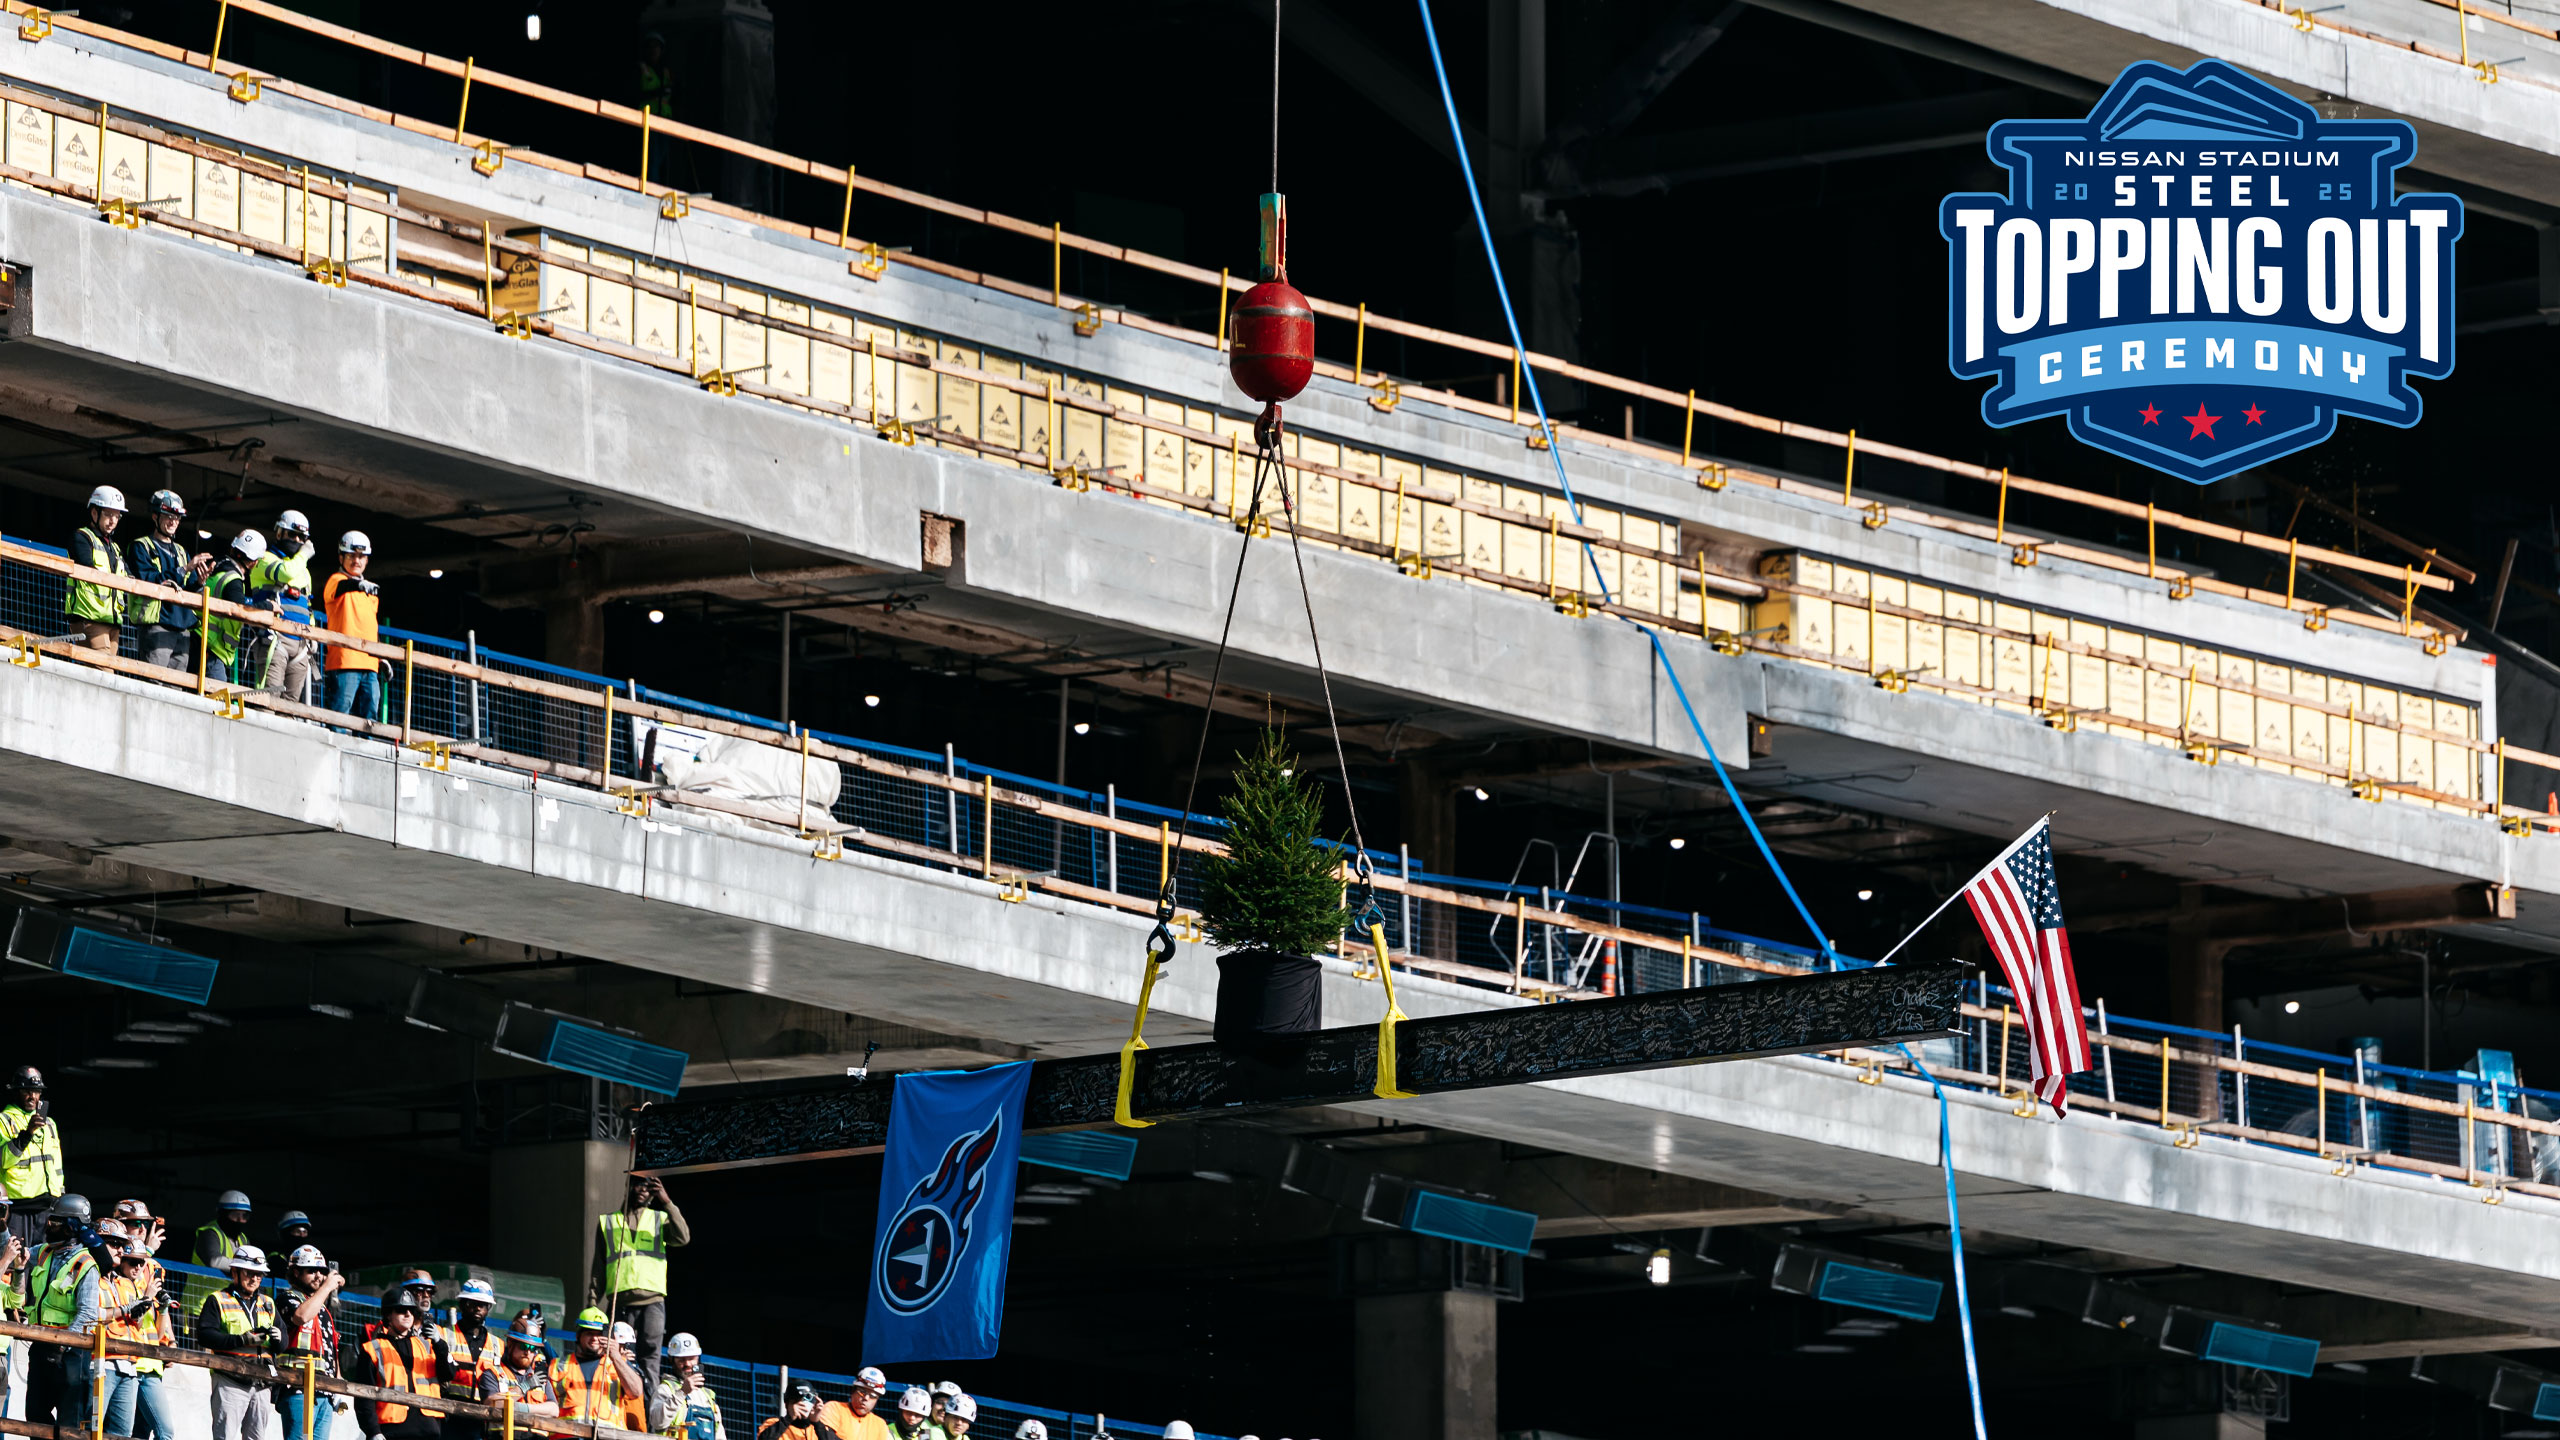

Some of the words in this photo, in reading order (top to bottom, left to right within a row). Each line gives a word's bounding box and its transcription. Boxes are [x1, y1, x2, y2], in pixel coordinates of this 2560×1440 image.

[22, 113, 37, 125] GP
[69, 141, 84, 153] GP
[116, 166, 130, 178] GP
[512, 261, 531, 273] GP
